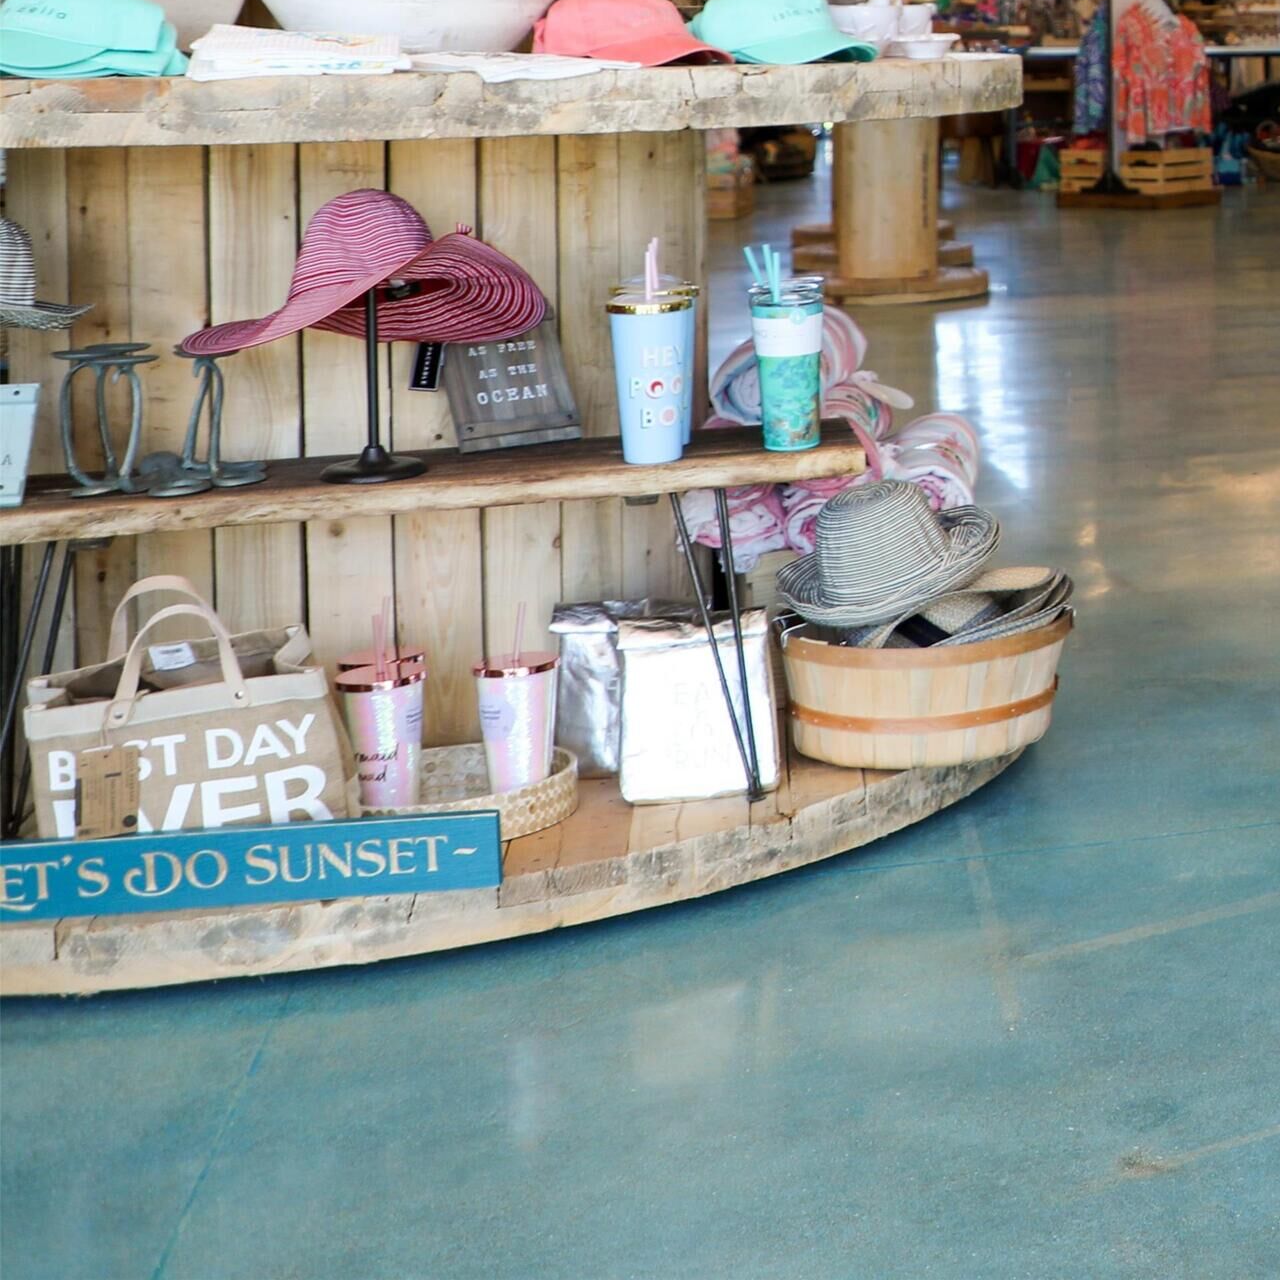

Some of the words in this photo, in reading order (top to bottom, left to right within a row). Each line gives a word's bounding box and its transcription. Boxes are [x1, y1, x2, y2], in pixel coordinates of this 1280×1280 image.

[468, 346, 488, 357] AS
[498, 339, 537, 354] FREE
[479, 368, 498, 380] AS
[507, 363, 538, 376] THE
[476, 383, 549, 406] OCEAN
[48, 732, 187, 793] BST
[205, 713, 317, 772] DAY
[0, 854, 110, 912] ET'S
[123, 849, 228, 898] DO
[244, 835, 450, 887] SUNSET
